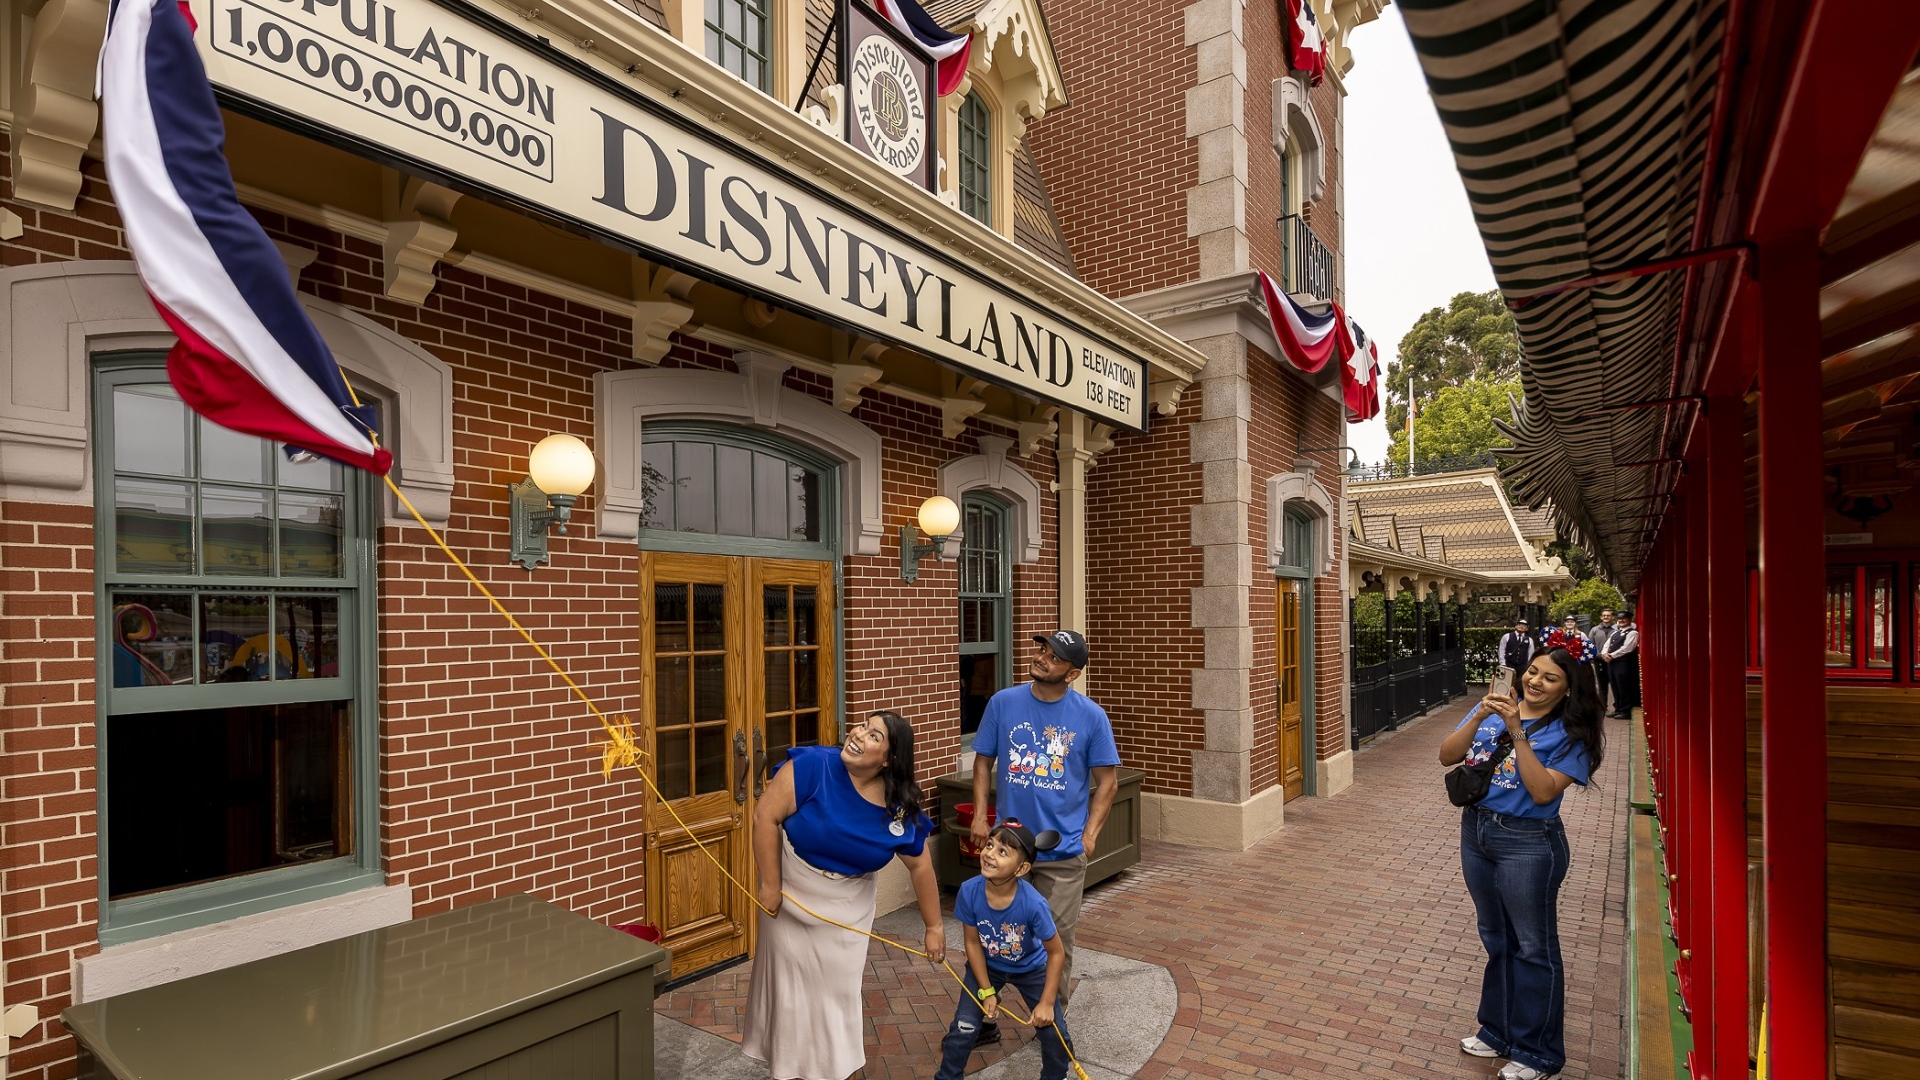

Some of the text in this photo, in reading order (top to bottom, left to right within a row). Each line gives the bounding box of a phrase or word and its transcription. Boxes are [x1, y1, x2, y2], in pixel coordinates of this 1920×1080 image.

[225, 7, 546, 168] 1,000,000,000
[275, 0, 555, 125] ULATION
[853, 43, 925, 120] Disneyland
[858, 104, 920, 169] RAILROAD
[590, 106, 1074, 388] DISNEYLAND
[1082, 347, 1136, 389] ELEVATION
[1086, 379, 1131, 414] 138 FEET
[1008, 749, 1065, 779] 2026
[1464, 747, 1516, 778] 206
